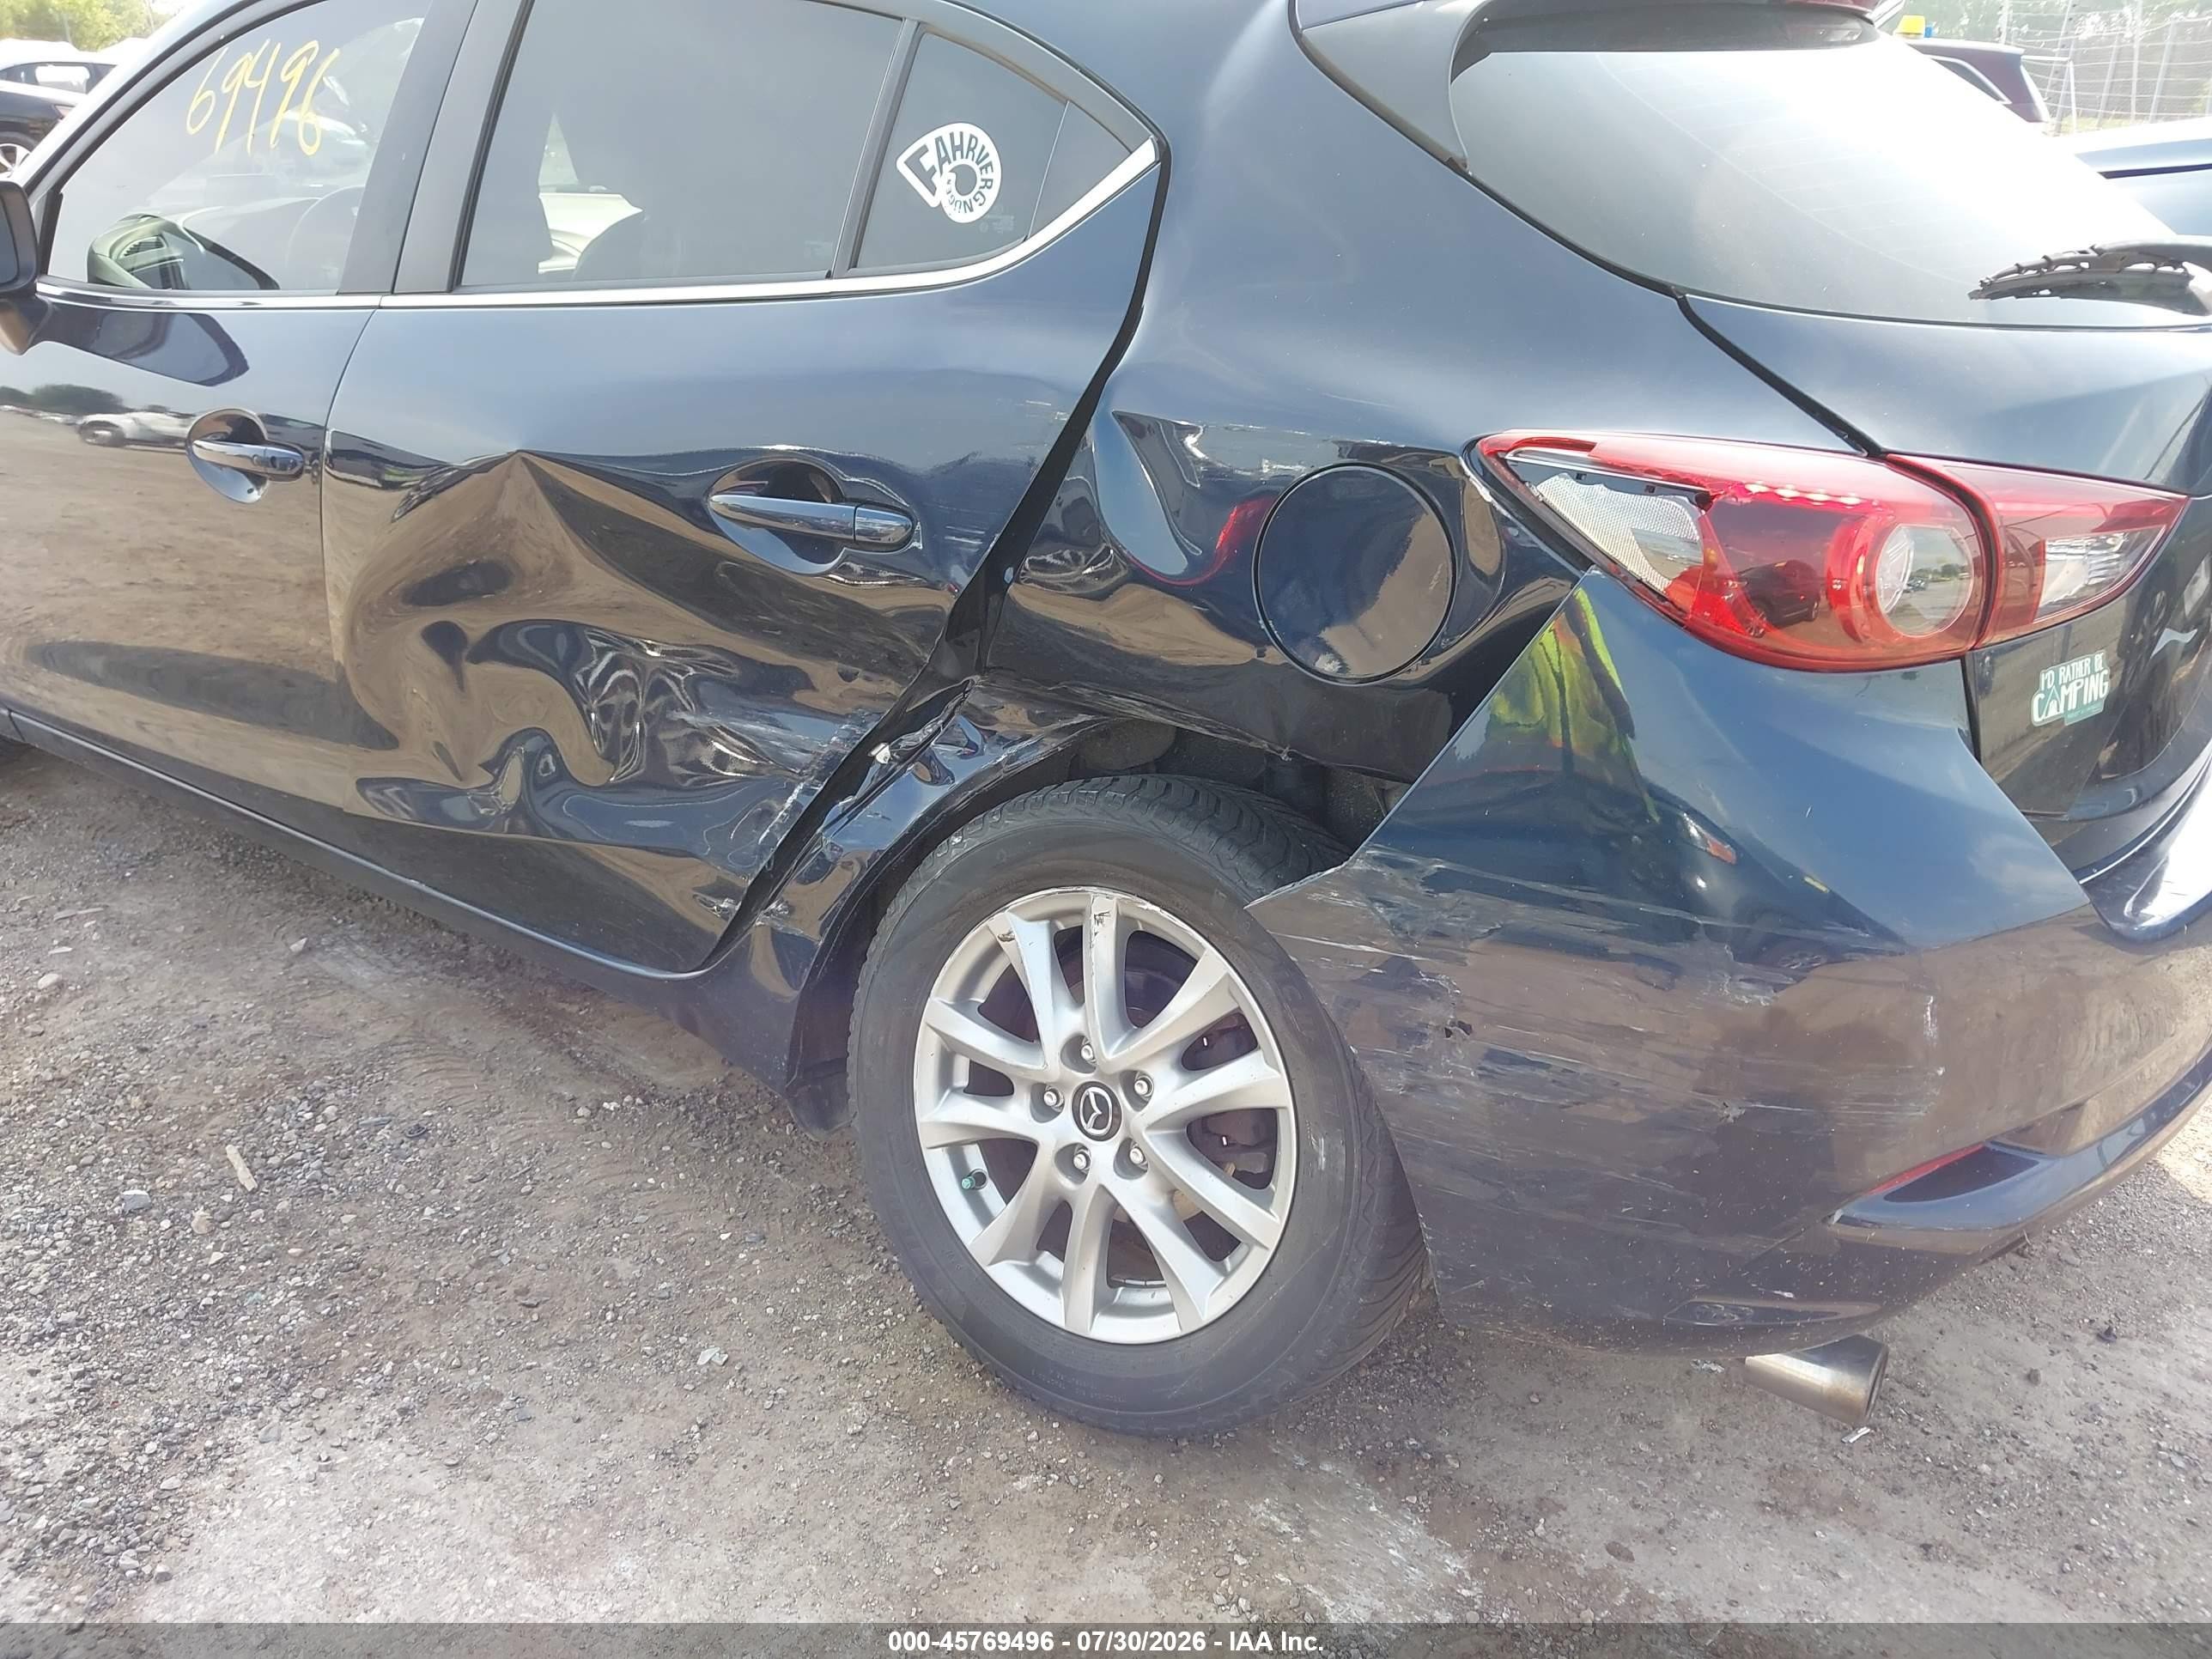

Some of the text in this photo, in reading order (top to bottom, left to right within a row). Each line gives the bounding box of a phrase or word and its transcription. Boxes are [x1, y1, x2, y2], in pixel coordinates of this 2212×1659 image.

[186, 39, 341, 156] 69496
[2033, 669, 2109, 722] CAMPING
[2040, 652, 2105, 691] I'D RATHER BE
